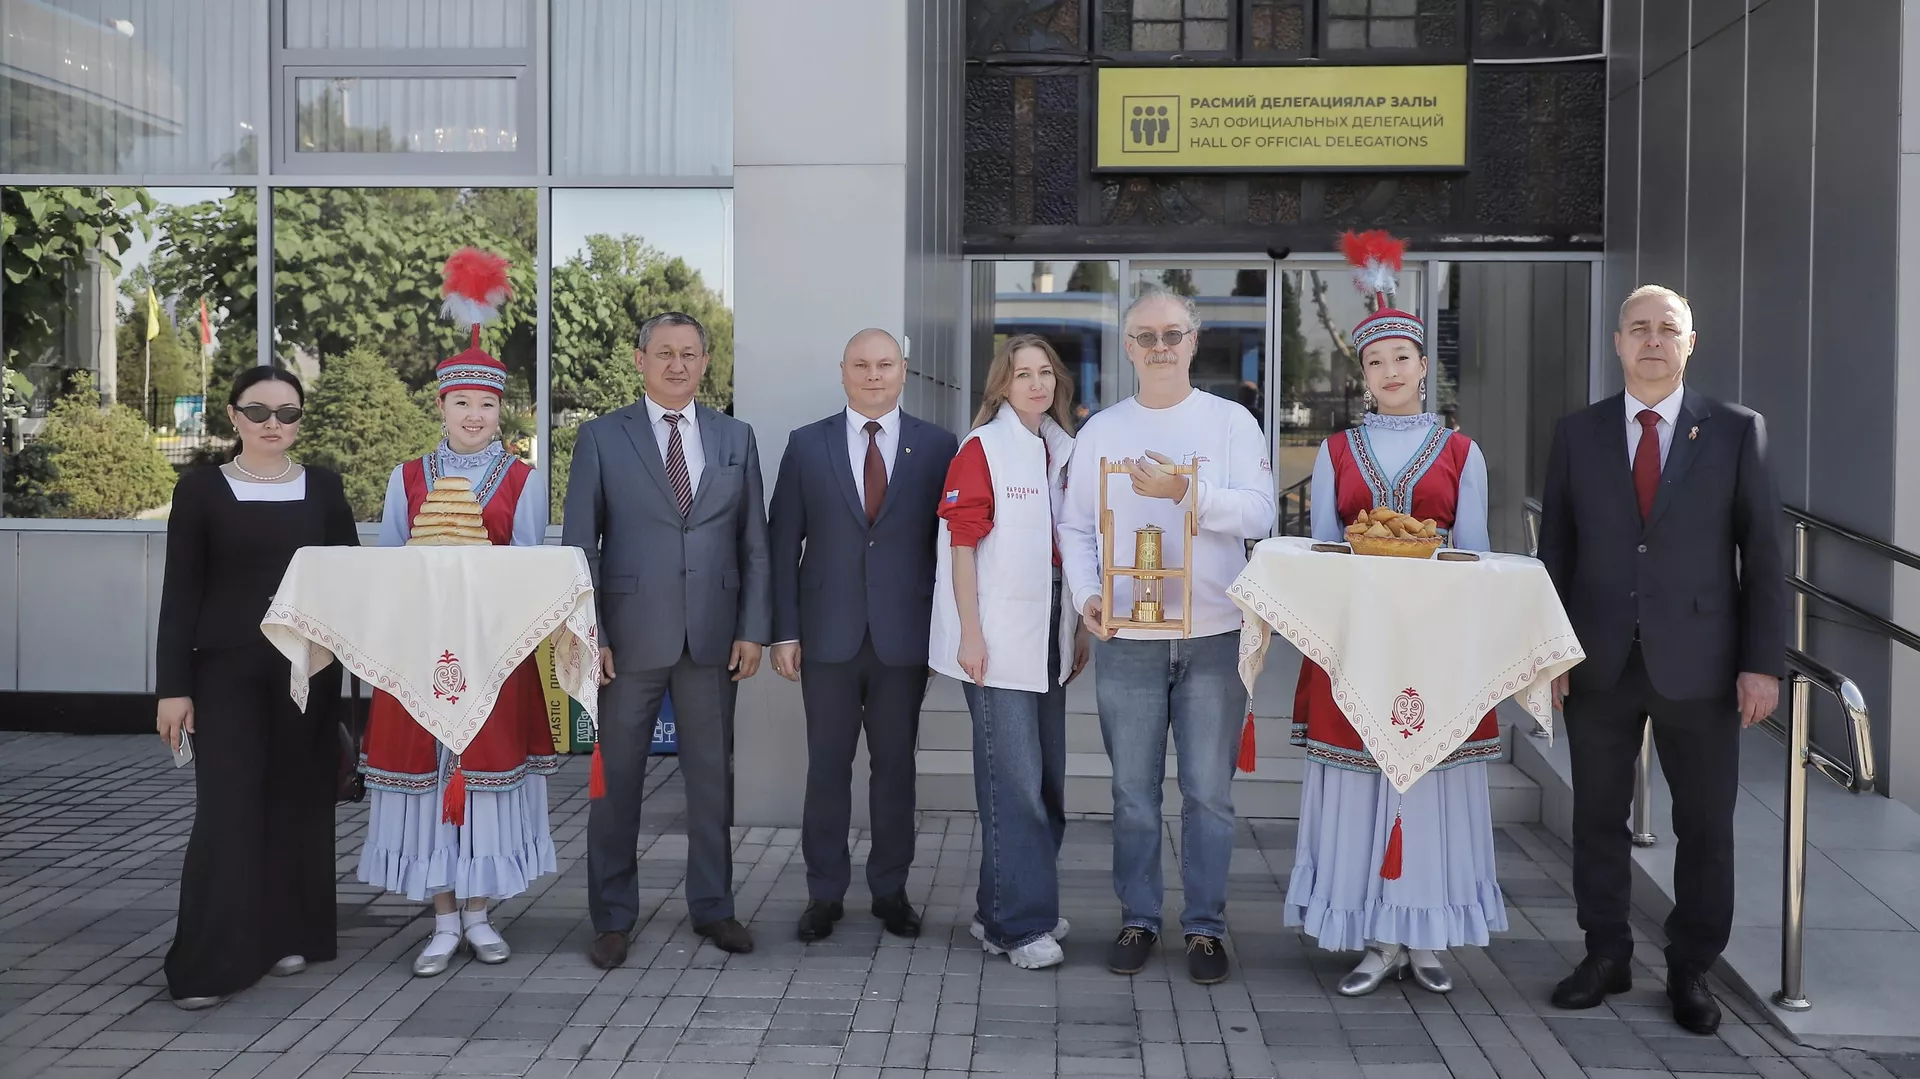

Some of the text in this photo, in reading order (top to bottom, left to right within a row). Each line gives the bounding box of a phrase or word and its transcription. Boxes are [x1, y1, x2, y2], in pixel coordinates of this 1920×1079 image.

[1190, 94, 1437, 110] РАСМИЙ ДЕЛЕГАЦИЯЛАР ЗАЛЫ
[1190, 113, 1444, 130] ЗАЛ ОФИЦИАЛЬНЫХ ДЕЛЕГАЦИЙ
[1190, 135, 1428, 148] HALL OF OFFICIAL DELEGATIONS
[550, 700, 562, 744] PLASTIC
